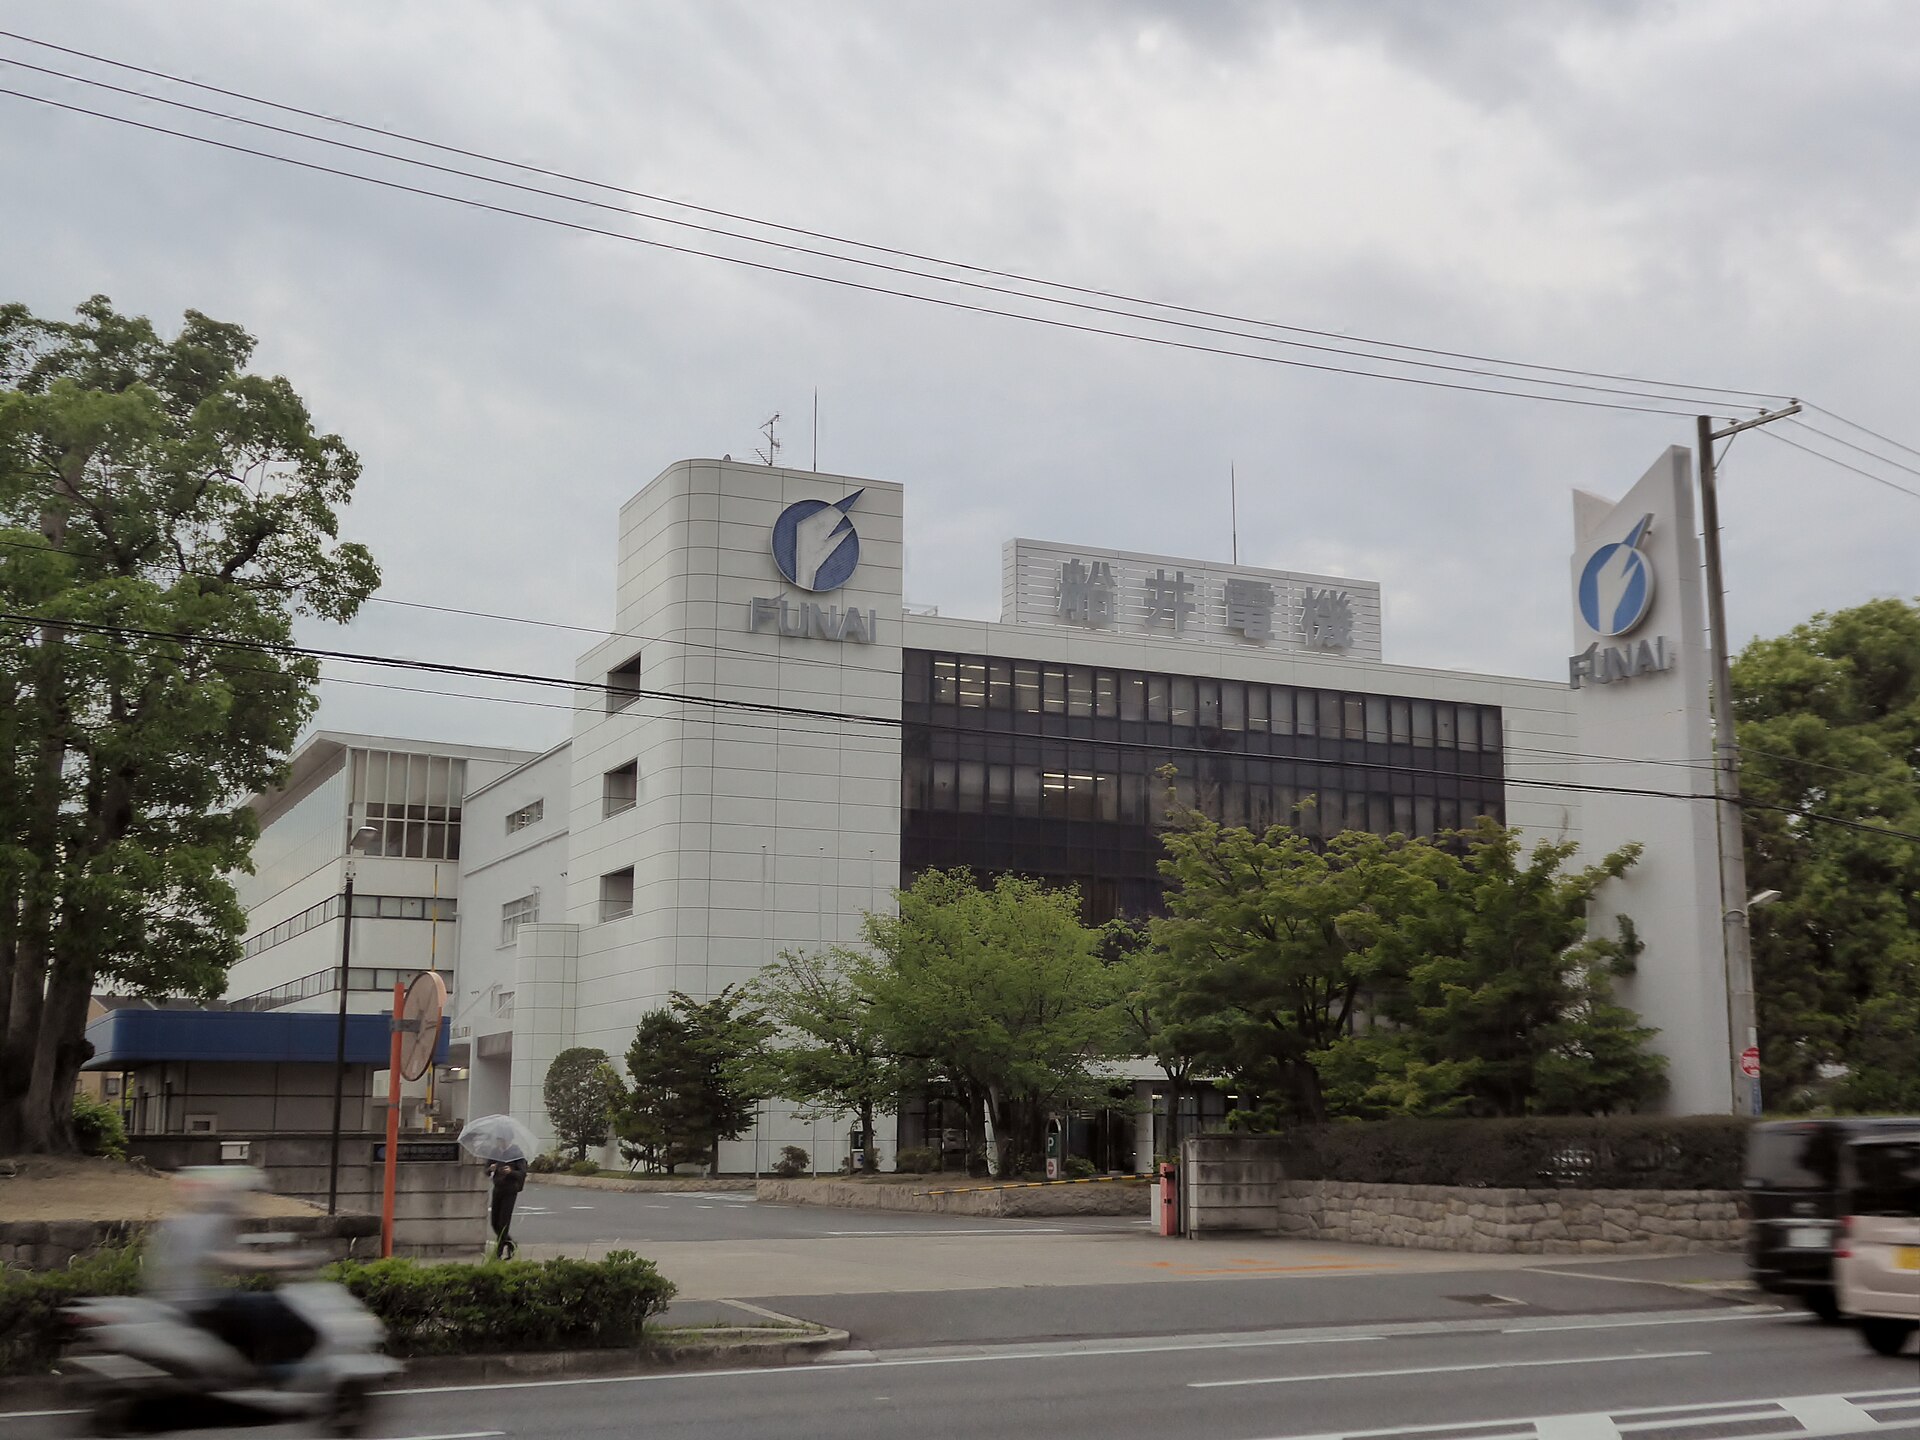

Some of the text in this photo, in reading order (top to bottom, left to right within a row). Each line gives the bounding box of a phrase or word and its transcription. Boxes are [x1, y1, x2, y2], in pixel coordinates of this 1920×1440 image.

[750, 592, 876, 643] FUNAI
[1057, 558, 1354, 649] 船井電機
[1569, 636, 1668, 689] FUNAI
[1047, 1136, 1055, 1152] P
